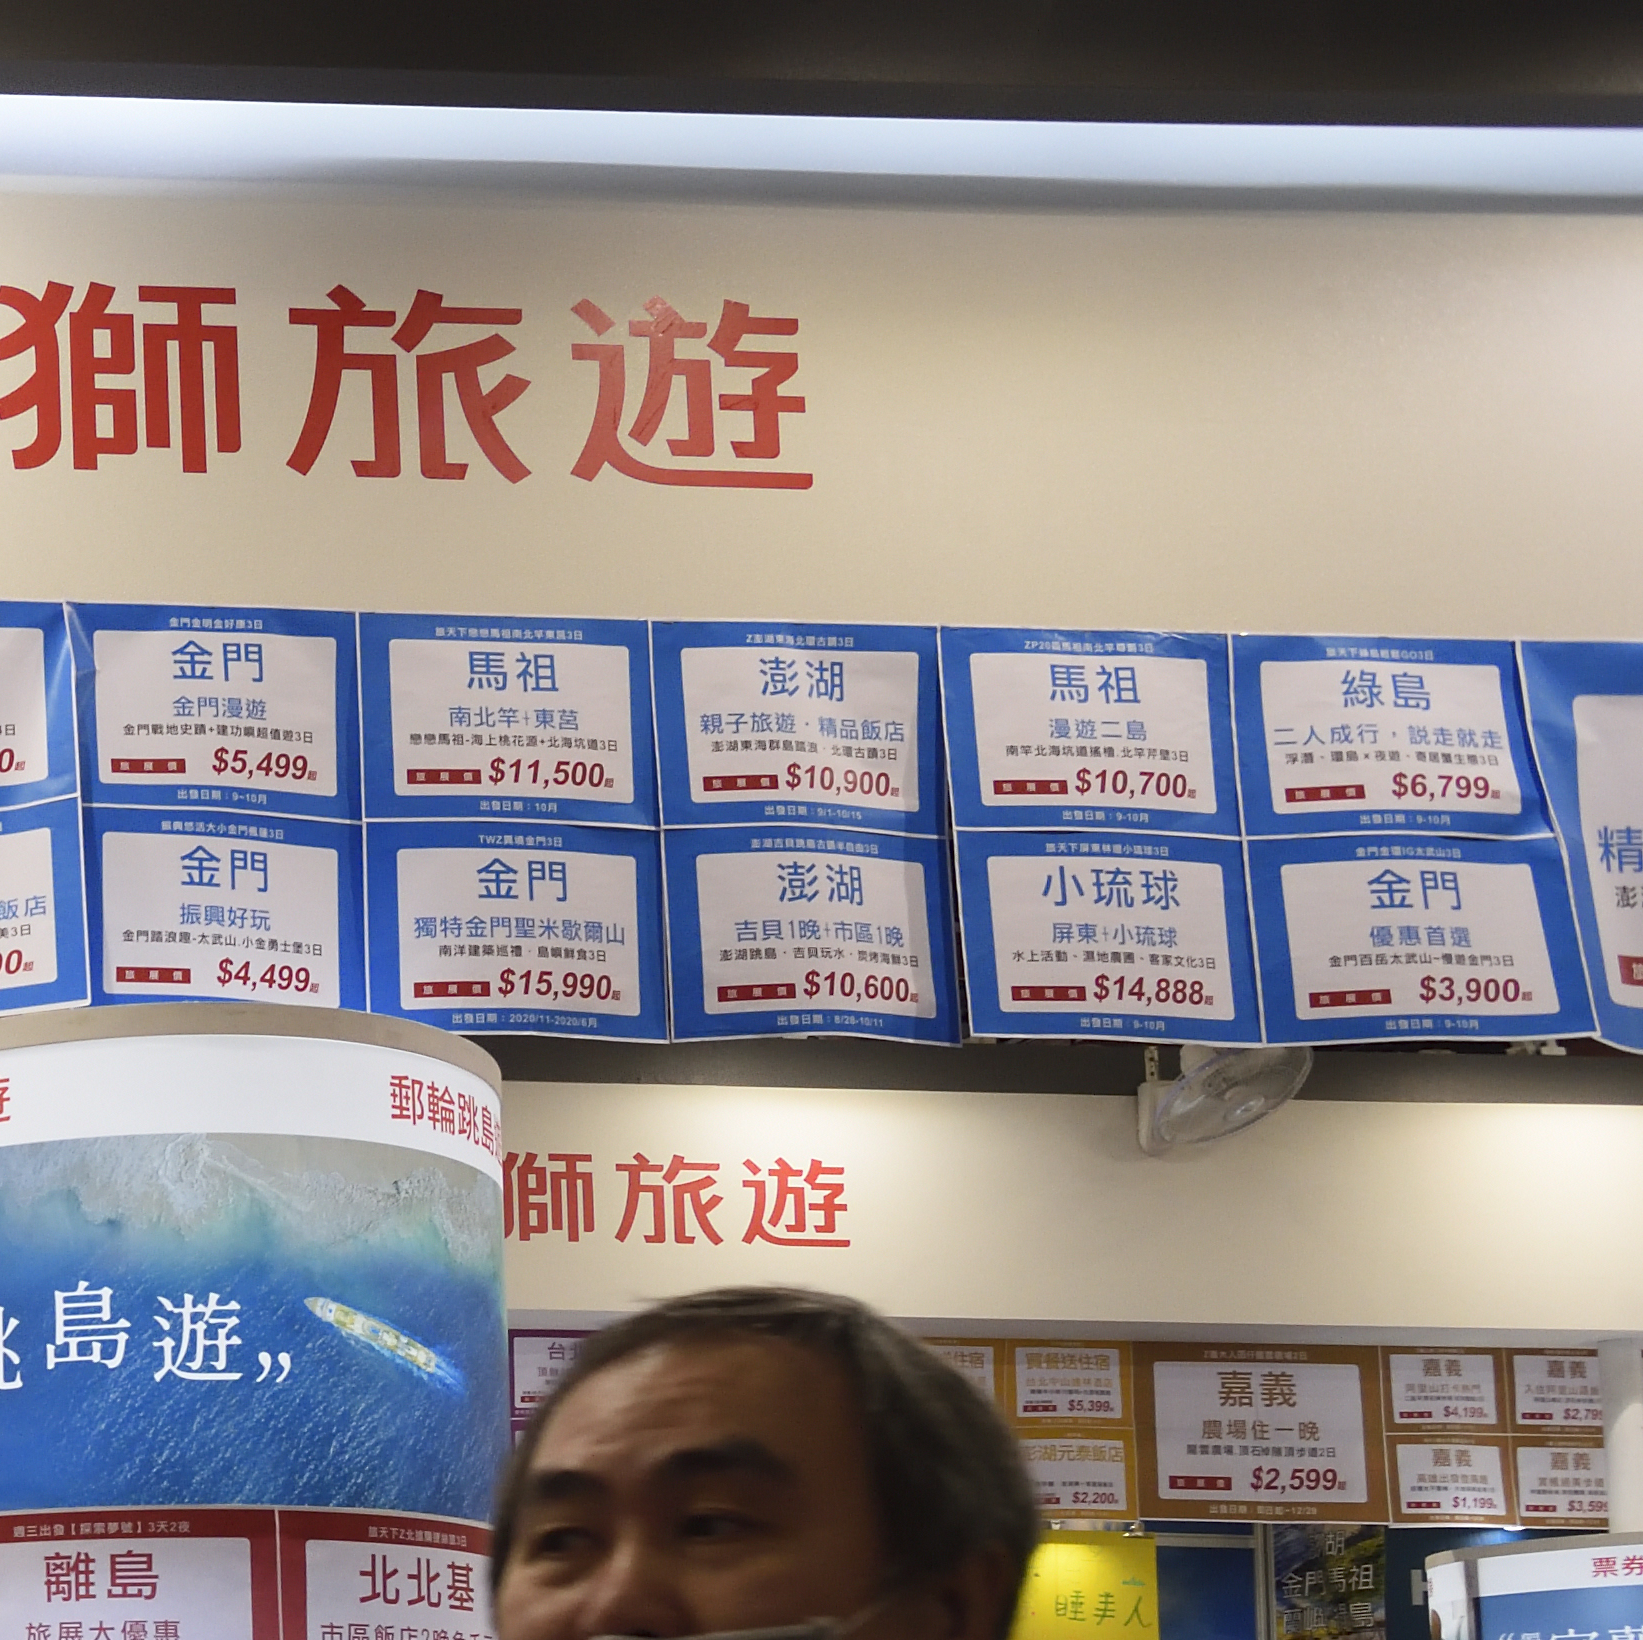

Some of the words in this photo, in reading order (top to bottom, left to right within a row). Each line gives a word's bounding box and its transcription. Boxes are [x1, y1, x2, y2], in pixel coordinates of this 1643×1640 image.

[172, 640, 263, 682] 金門
[468, 651, 559, 692] 馬祖
[760, 657, 844, 702] 澎湖
[1050, 664, 1141, 704] 馬祖
[1341, 670, 1430, 710] 綠島
[173, 696, 266, 720] 金門漫遊
[1049, 719, 1146, 741] 漫遊二島
[180, 845, 268, 892] 金門
[477, 858, 567, 902] 金門
[777, 861, 863, 906] 澎湖
[1042, 866, 1180, 910] 小琉球
[1367, 869, 1461, 910] 金門
[180, 903, 270, 931] 振興好玩
[415, 916, 624, 947] 獨特金門聖米歇爾山
[1369, 925, 1471, 947] 優惠首選
[1217, 1371, 1296, 1407] 嘉義
[1202, 1419, 1319, 1441] 農場住一晚
[44, 1550, 159, 1602] 離島
[359, 1554, 474, 1611] 北北基
